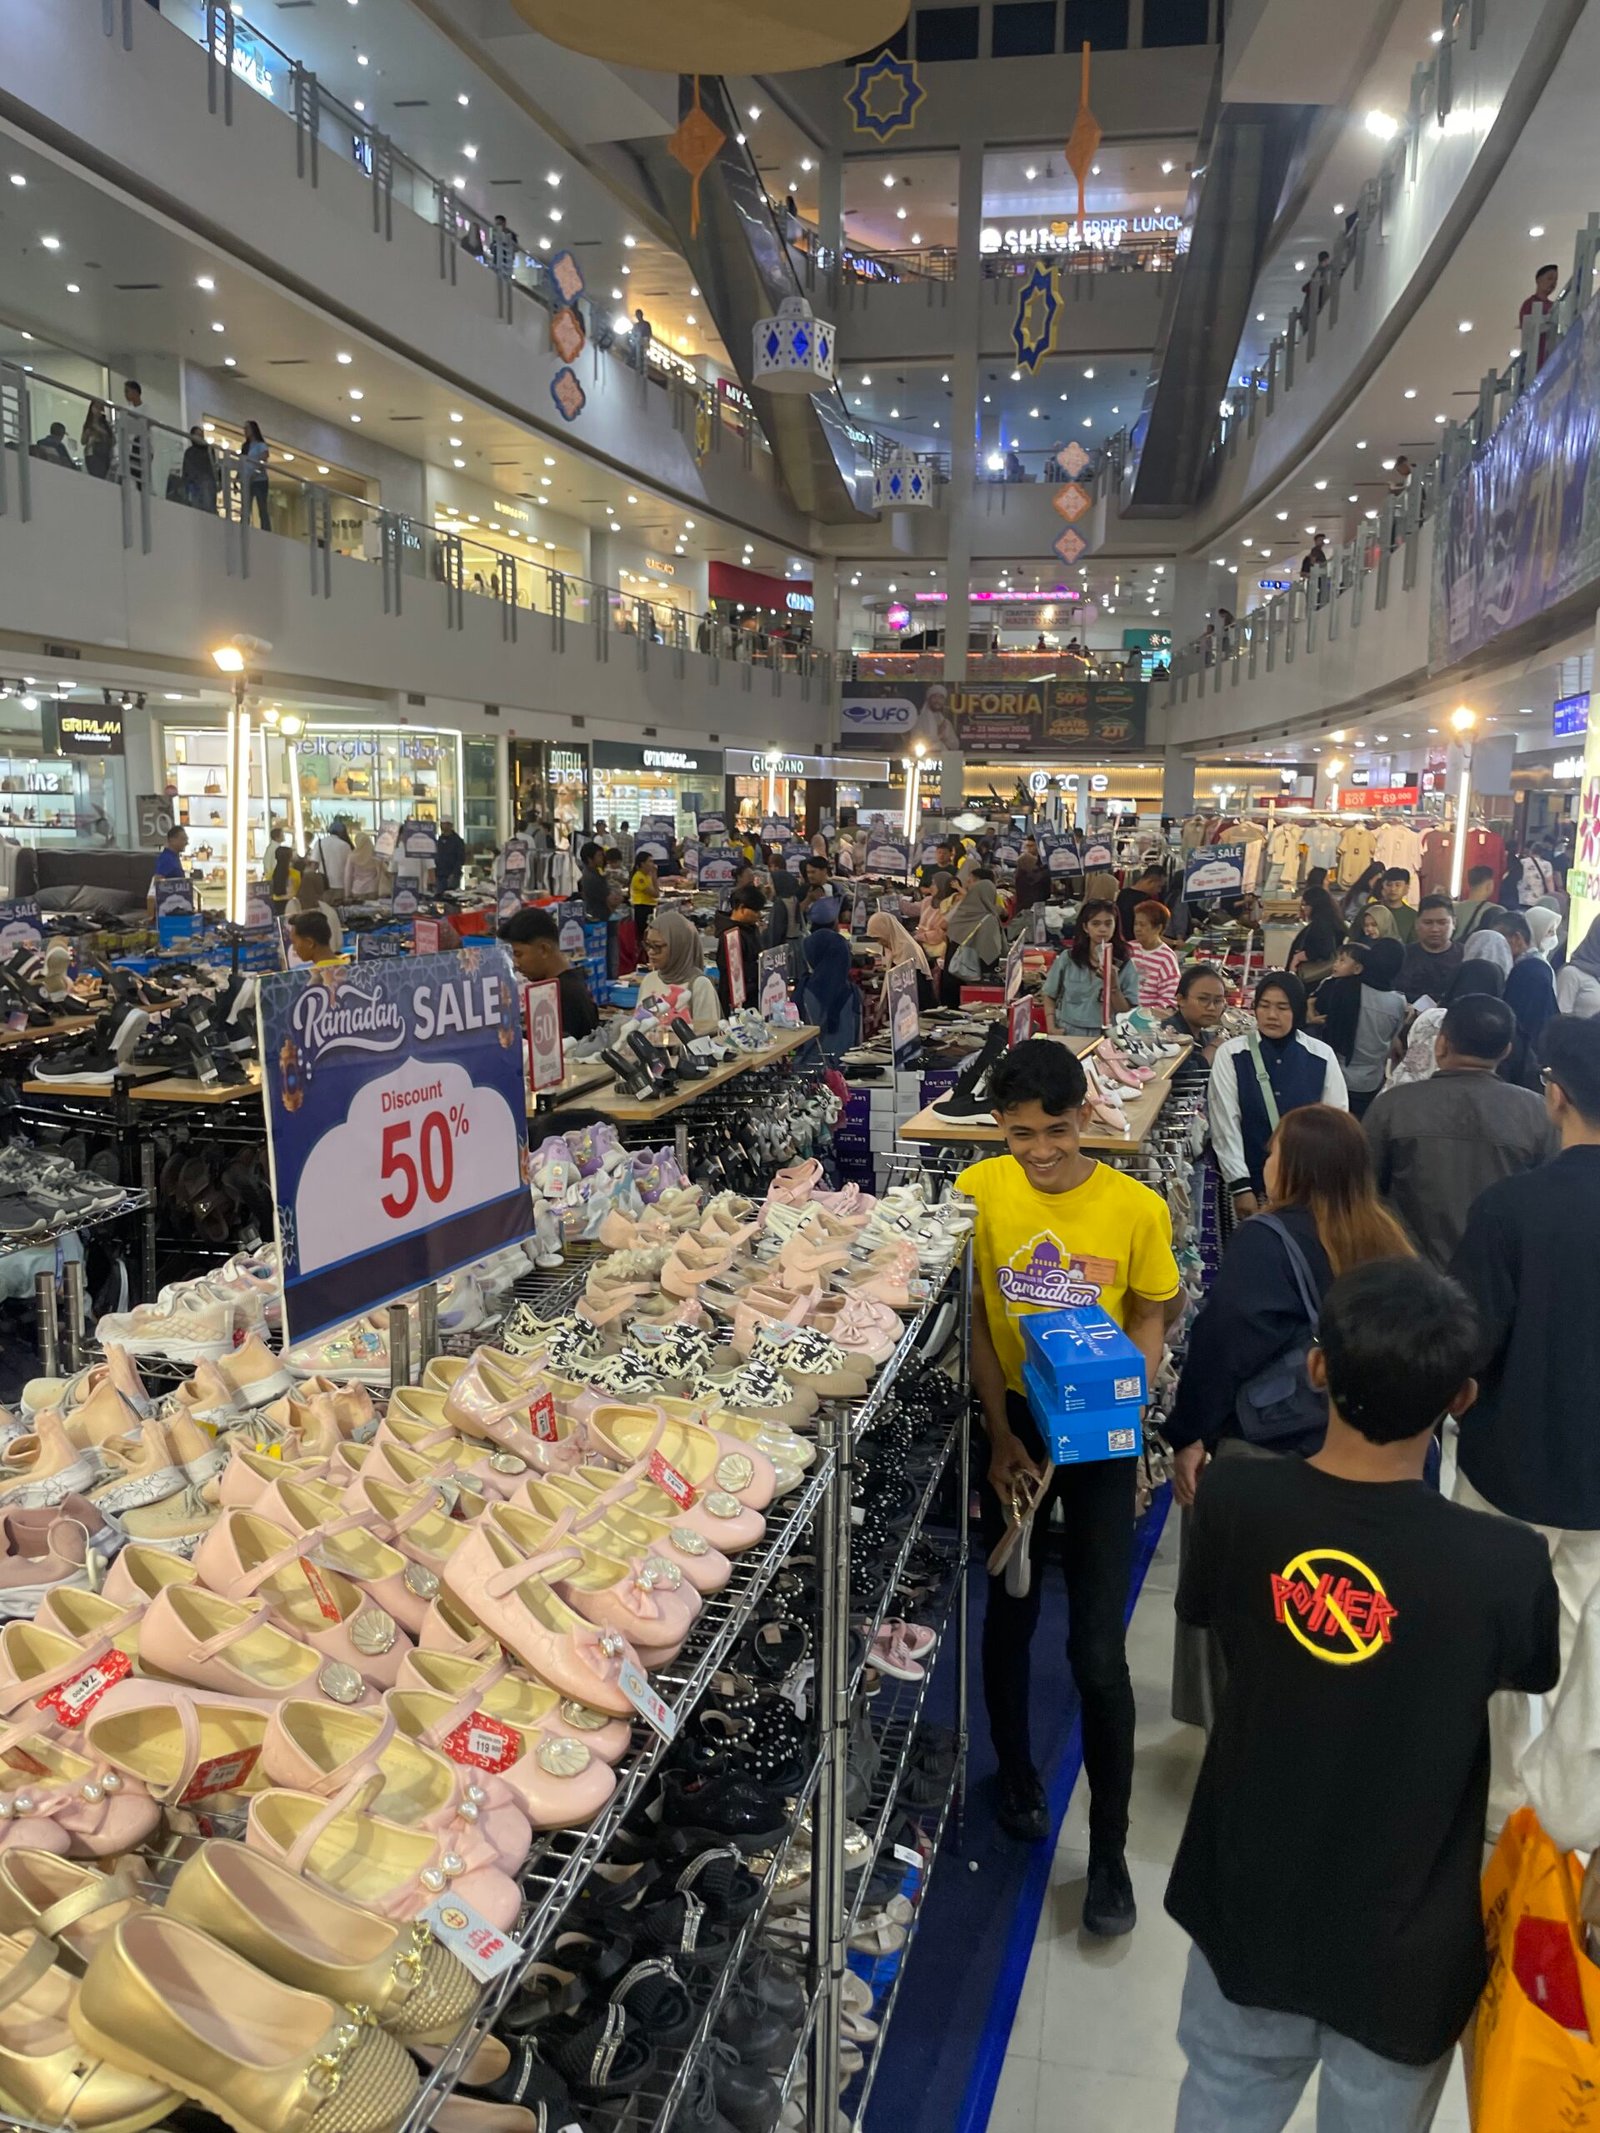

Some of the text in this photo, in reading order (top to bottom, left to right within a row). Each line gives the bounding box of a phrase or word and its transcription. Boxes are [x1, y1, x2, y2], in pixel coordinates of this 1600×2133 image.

[951, 693, 1042, 715] UFORIA
[1055, 691, 1087, 704] 50%
[872, 707, 909, 721] UFO
[294, 735, 378, 762] ellagio
[888, 836, 906, 846] SALE
[1058, 836, 1072, 845] SALE
[721, 851, 739, 859] SALE
[1217, 847, 1241, 858] SALE
[175, 883, 190, 892] SALE
[255, 885, 271, 895] SALE
[15, 903, 38, 918] SALE
[381, 942, 397, 954] SALE
[774, 952, 786, 968] SALE
[902, 969, 914, 988] SALE
[293, 976, 501, 1062] Ramadan SALE
[381, 1080, 443, 1113] Discount
[381, 1103, 470, 1219] 50%
[997, 1266, 1102, 1308] Ramadhan
[475, 1740, 490, 1753] 119
